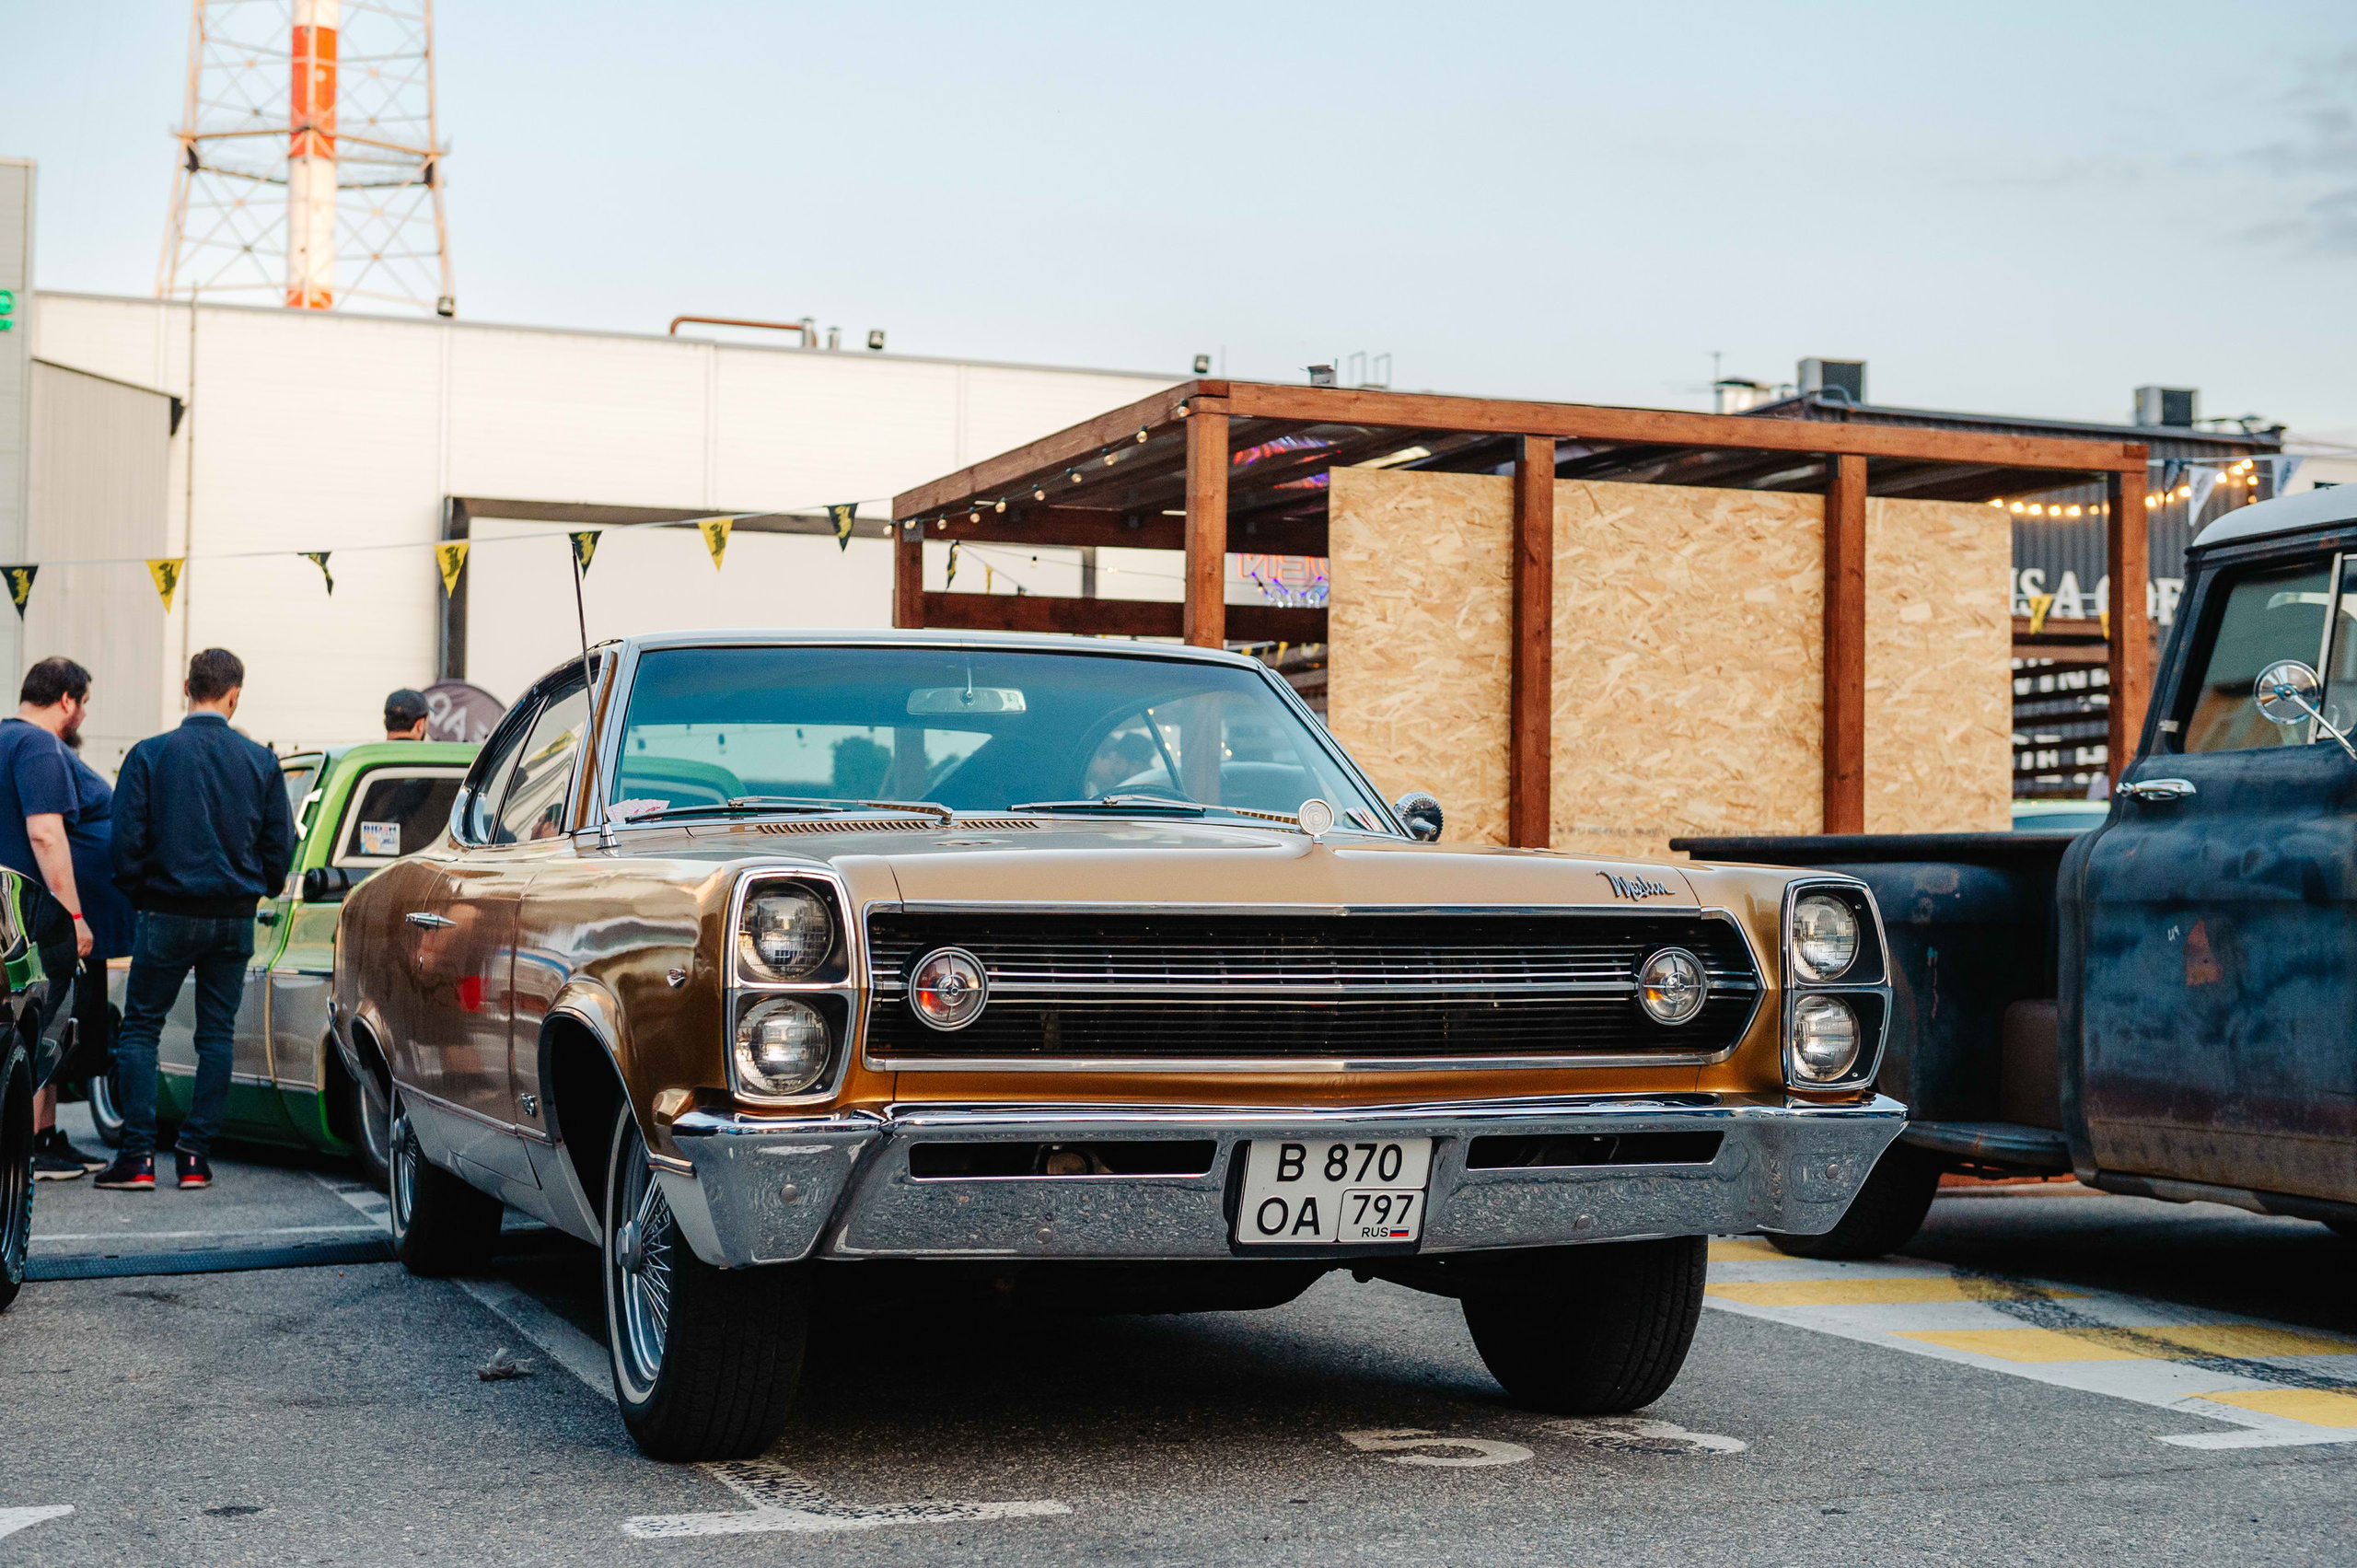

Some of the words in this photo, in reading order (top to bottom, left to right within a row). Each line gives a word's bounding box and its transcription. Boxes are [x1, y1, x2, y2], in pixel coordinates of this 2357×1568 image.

[1277, 1144, 1306, 1182] B
[1324, 1144, 1402, 1182] 870
[1257, 1197, 1320, 1236] OA
[1353, 1194, 1414, 1225] 797
[1361, 1226, 1388, 1237] RUS
